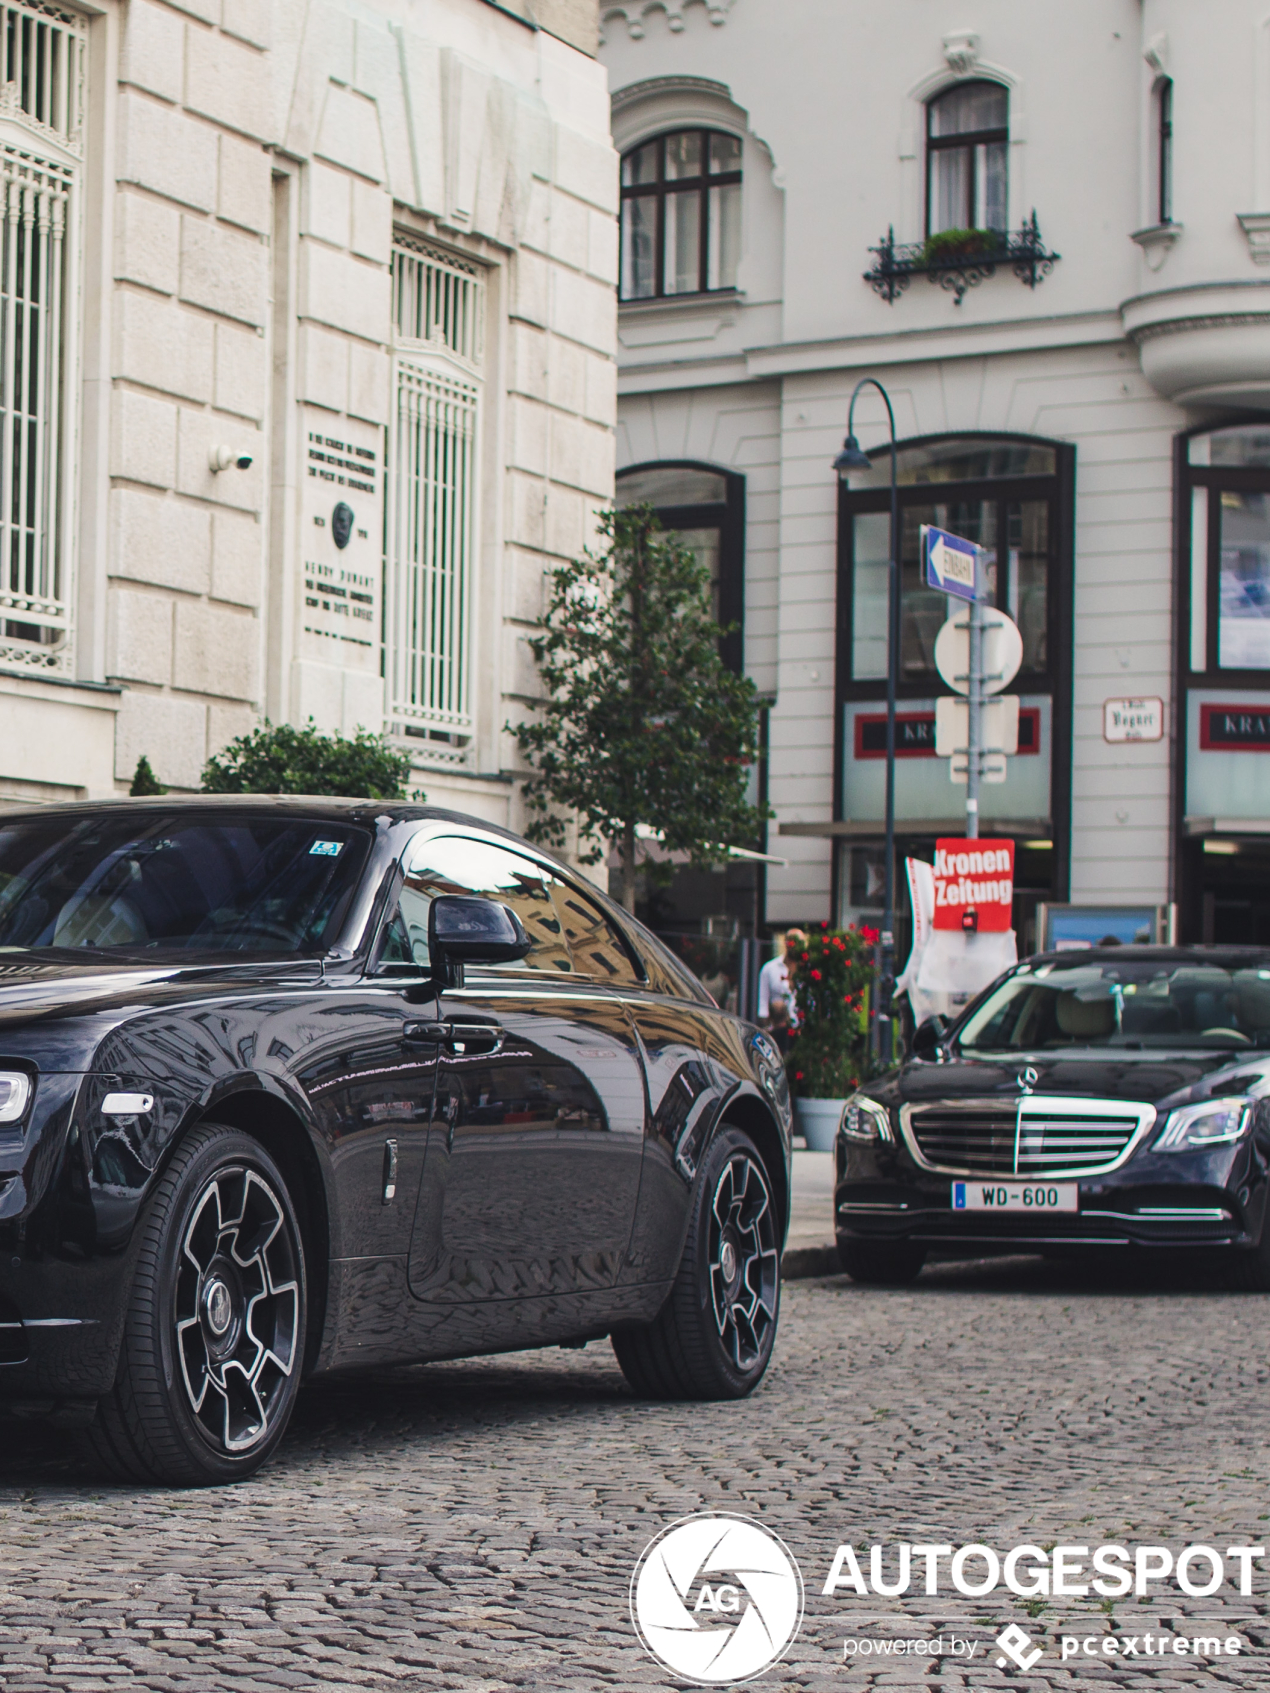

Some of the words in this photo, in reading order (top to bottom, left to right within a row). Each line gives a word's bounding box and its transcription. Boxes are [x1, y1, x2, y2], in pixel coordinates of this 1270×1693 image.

[904, 722, 936, 741] KR
[1224, 714, 1270, 735] KRA
[934, 848, 1011, 877] Kronen
[935, 877, 1013, 907] Zeitung
[982, 1187, 1059, 1207] WD-600
